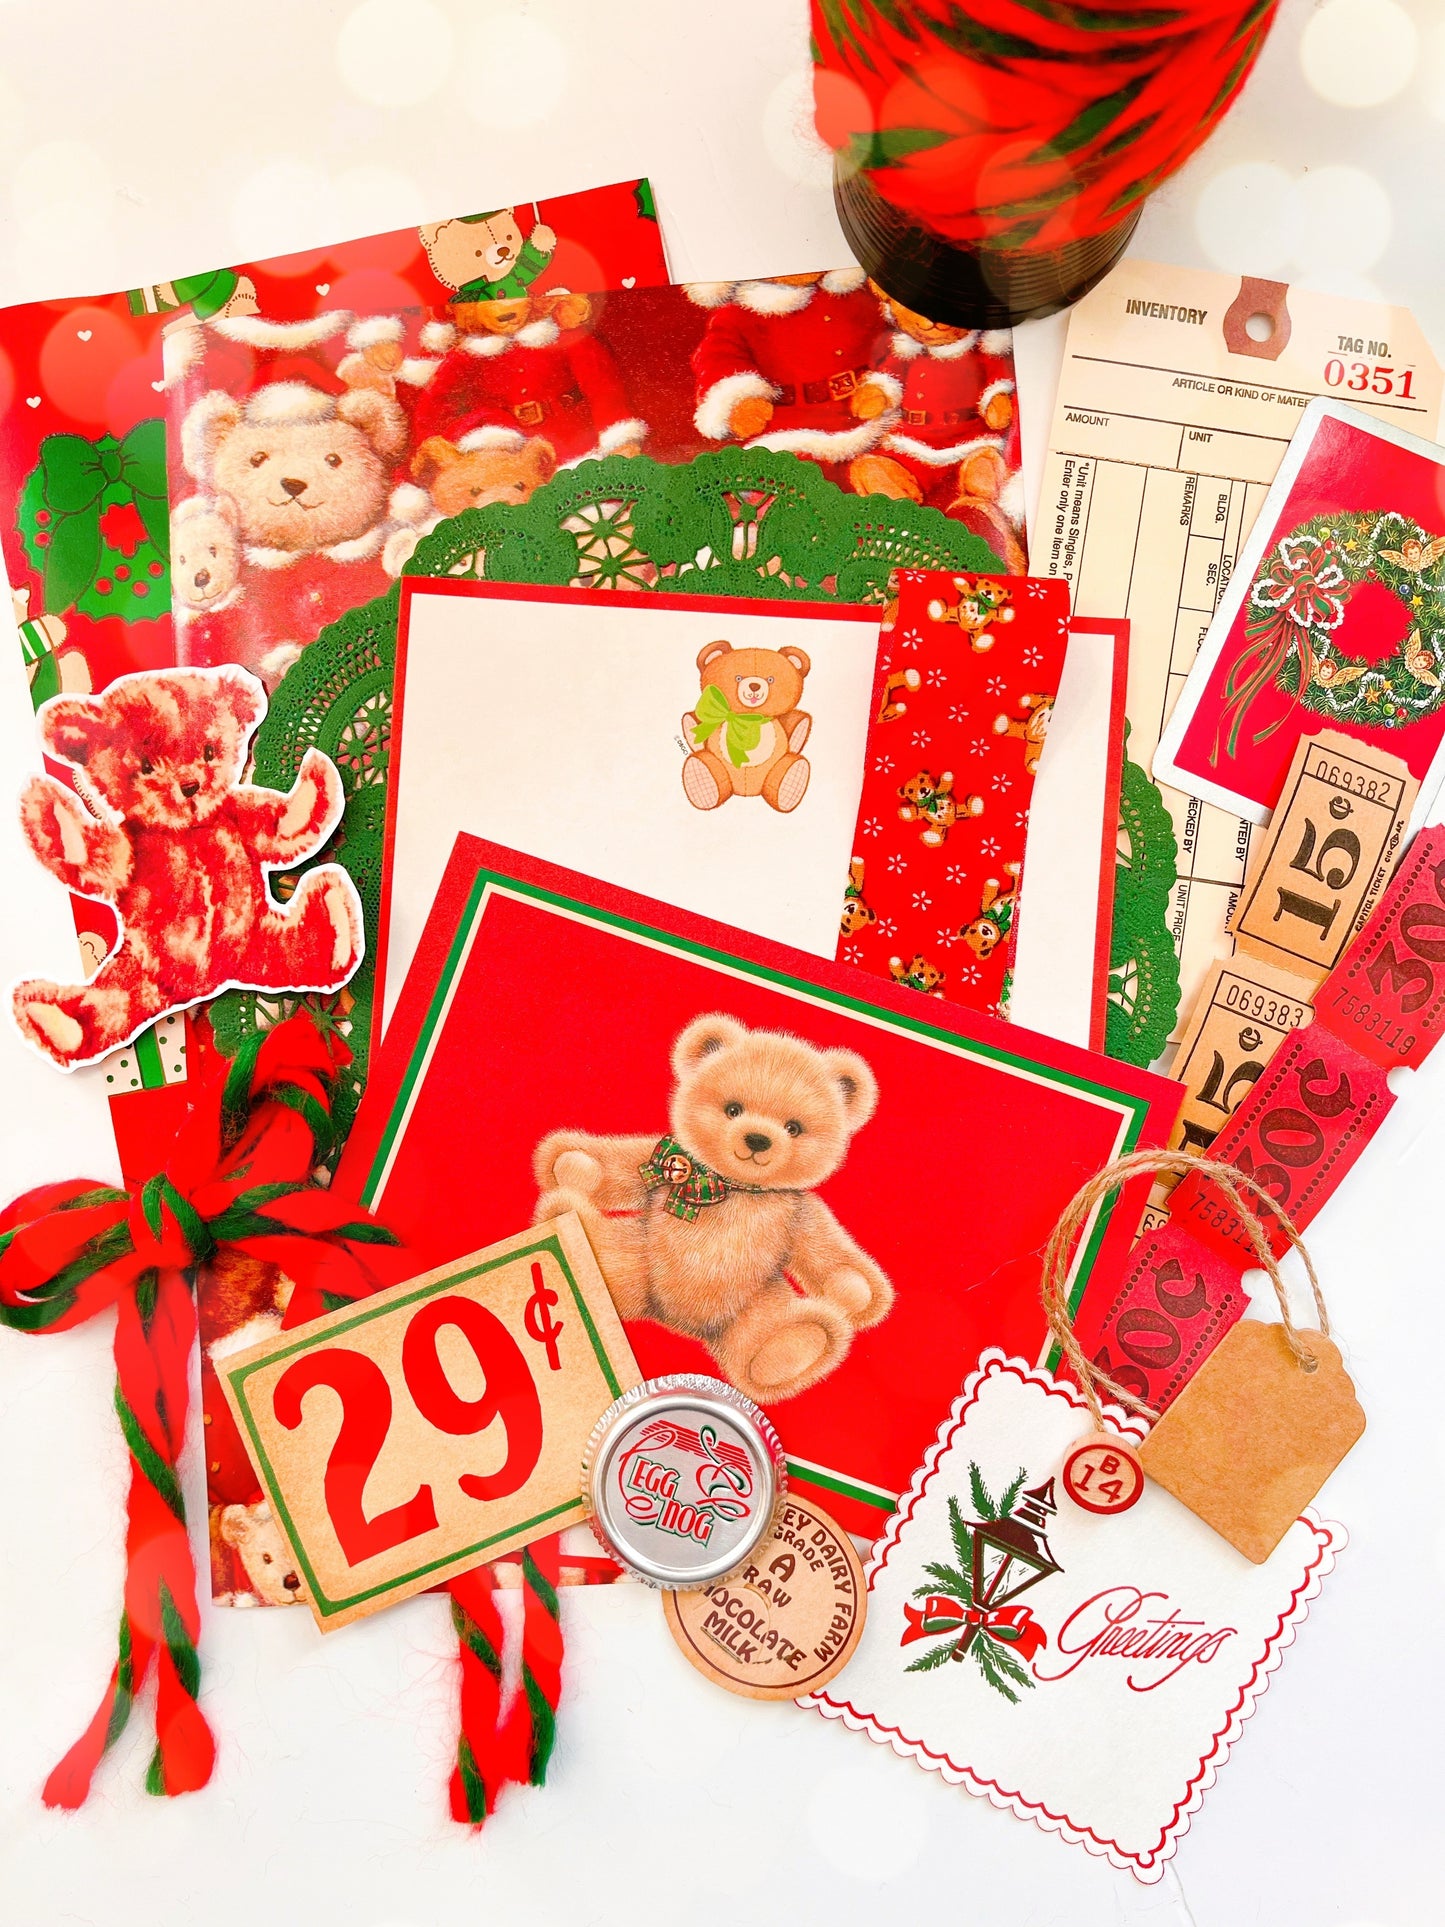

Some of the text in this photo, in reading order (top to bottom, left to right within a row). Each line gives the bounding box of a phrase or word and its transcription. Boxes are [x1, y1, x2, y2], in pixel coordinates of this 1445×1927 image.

[1126, 299, 1208, 326] INVENTORY
[1338, 336, 1392, 358] TAG NO.
[1172, 378, 1310, 408] ARTICLE OR KIND OF MATER
[1324, 360, 1416, 400] 0351
[1065, 412, 1110, 427] AMOUNT
[1189, 431, 1213, 444] UNIT
[1048, 460, 1075, 576] Enter only one item on
[1070, 488, 1083, 526] means
[1179, 476, 1195, 526] REMARKS
[1214, 494, 1228, 524] BLDG.
[1206, 562, 1218, 587] SEC.
[1315, 760, 1392, 803] 069382
[1183, 797, 1199, 854] HECKED BY
[1235, 817, 1248, 862] NTED BY
[1176, 884, 1188, 909] UNIT
[1355, 898, 1375, 932] CAPITOL
[1370, 867, 1387, 896] TICKET
[1366, 859, 1445, 1014] 30
[1226, 984, 1304, 1027] 069383
[1331, 986, 1416, 1056] 7583119
[631, 1458, 679, 1498] EGG
[1074, 1463, 1123, 1503] 14
[1099, 1454, 1121, 1475] B
[660, 1500, 714, 1541] NOG
[768, 1553, 796, 1583] A
[773, 1525, 825, 1573] GRADE
[742, 1565, 792, 1608] RAW
[783, 1508, 852, 1663] EY DAIRY FARM
[703, 1585, 808, 1671] OCOLATE
[703, 1610, 758, 1664] MILK
[1033, 1586, 1238, 1692] Greetings
